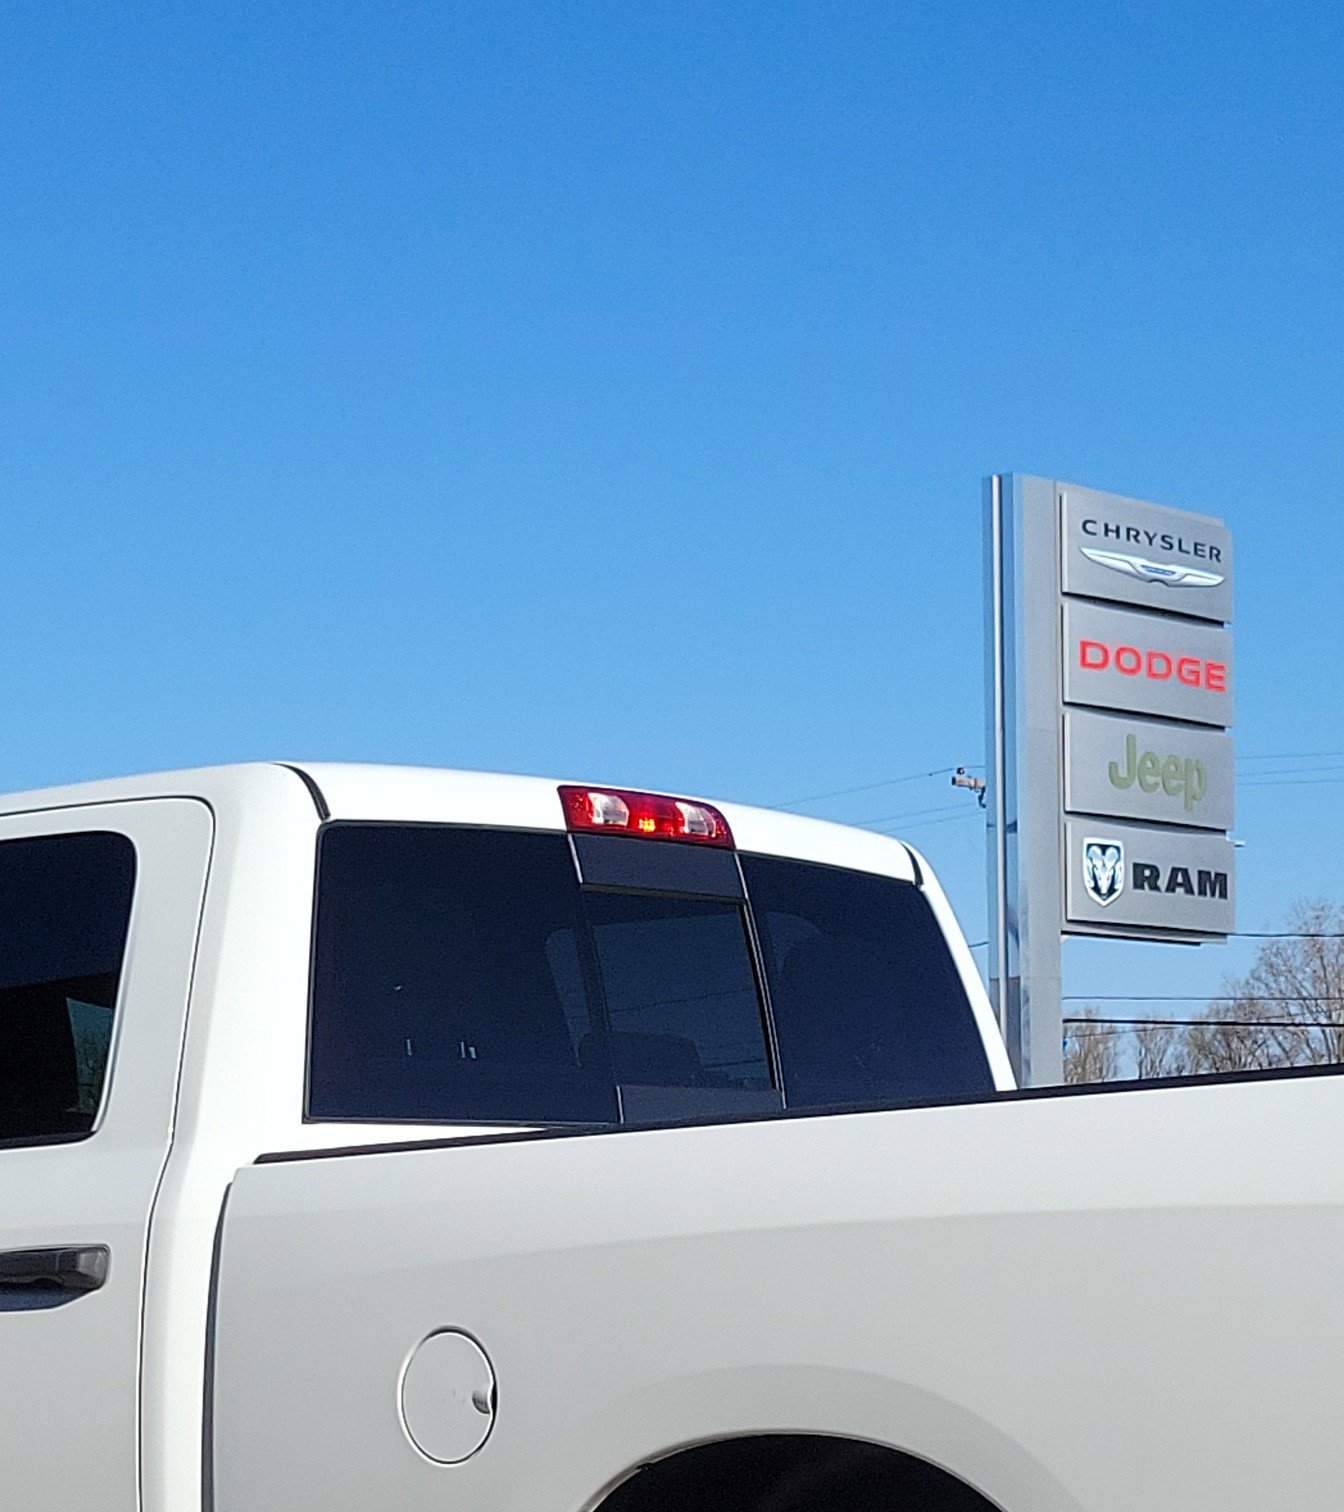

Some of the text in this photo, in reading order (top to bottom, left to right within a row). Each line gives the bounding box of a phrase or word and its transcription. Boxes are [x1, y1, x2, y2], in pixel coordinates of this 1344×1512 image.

[1082, 518, 1223, 564] CHRYSLER
[1078, 638, 1227, 694] DODGE
[1108, 733, 1208, 812] Jeep
[1132, 861, 1229, 901] RAM
